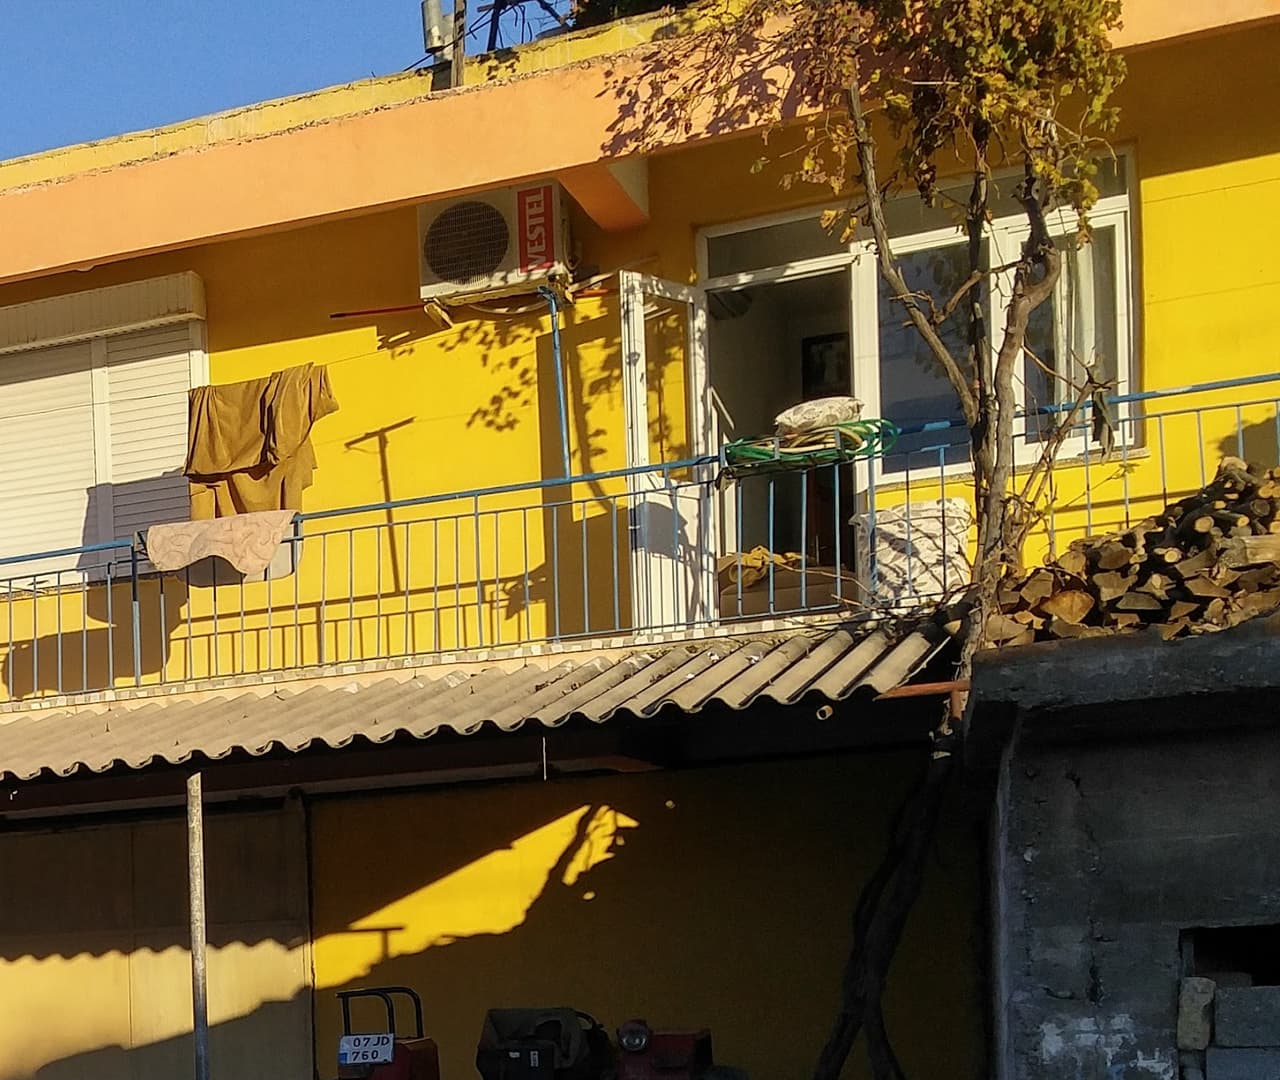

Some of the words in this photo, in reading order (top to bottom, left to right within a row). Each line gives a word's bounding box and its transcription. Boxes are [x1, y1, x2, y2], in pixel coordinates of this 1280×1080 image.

[525, 186, 546, 270] VESTEL
[353, 1037, 371, 1048] 07
[372, 1036, 390, 1047] JD
[351, 1050, 379, 1061] 760
